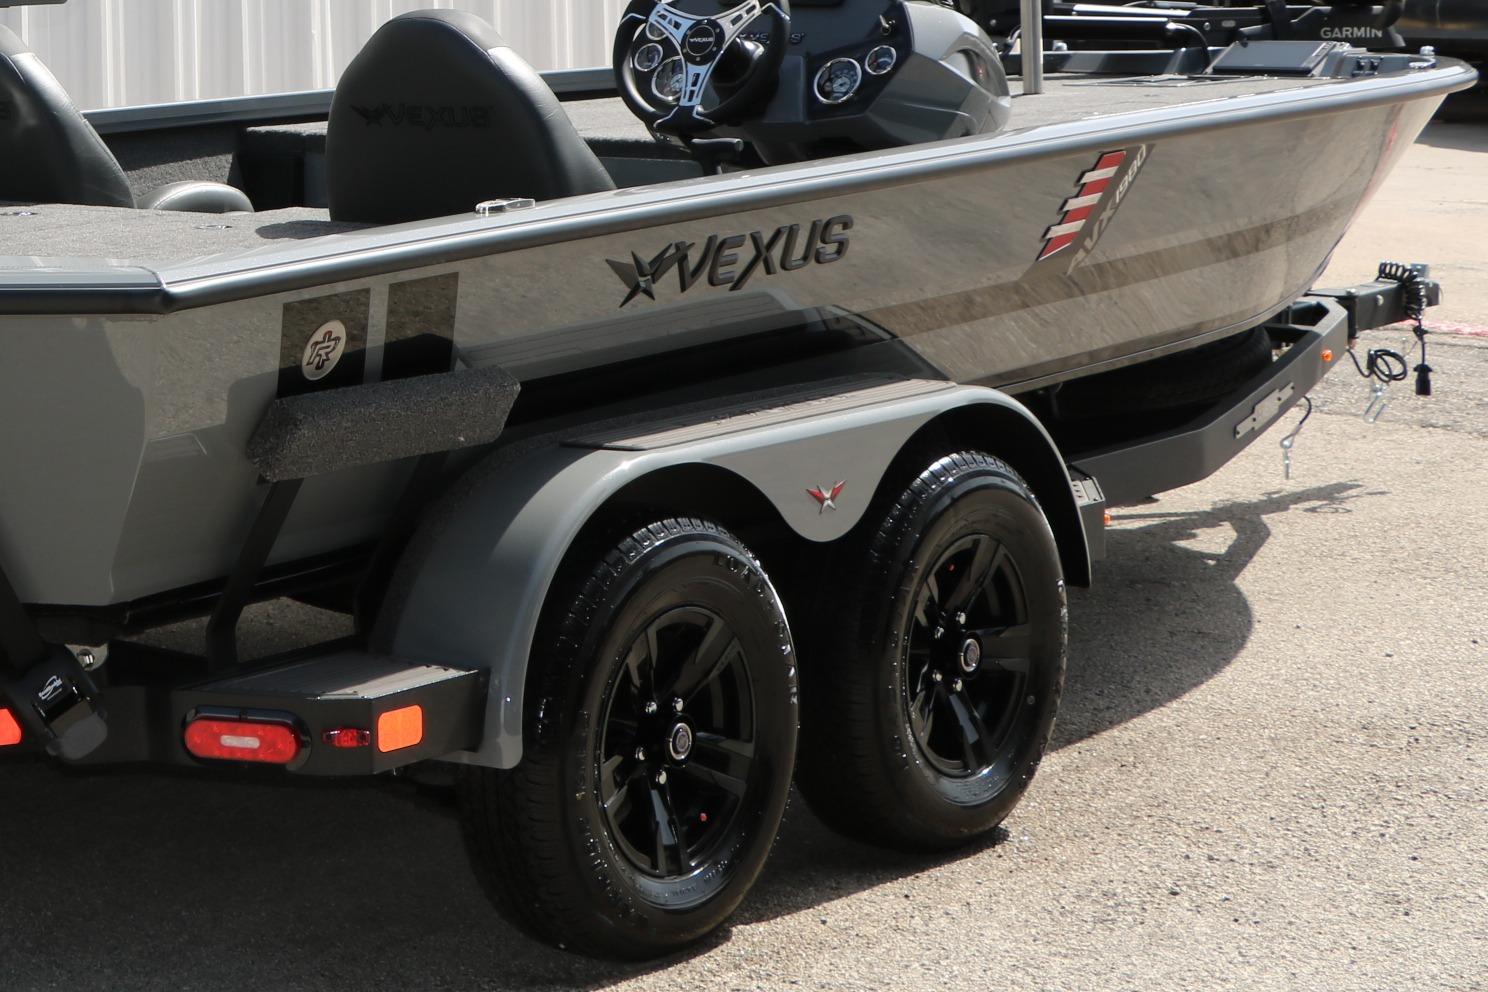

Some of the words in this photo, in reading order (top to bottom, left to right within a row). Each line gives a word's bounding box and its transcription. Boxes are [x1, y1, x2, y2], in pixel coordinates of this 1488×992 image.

[1320, 27, 1384, 39] GARMIN
[382, 102, 490, 131] VEXUS
[675, 214, 854, 293] VEXUS
